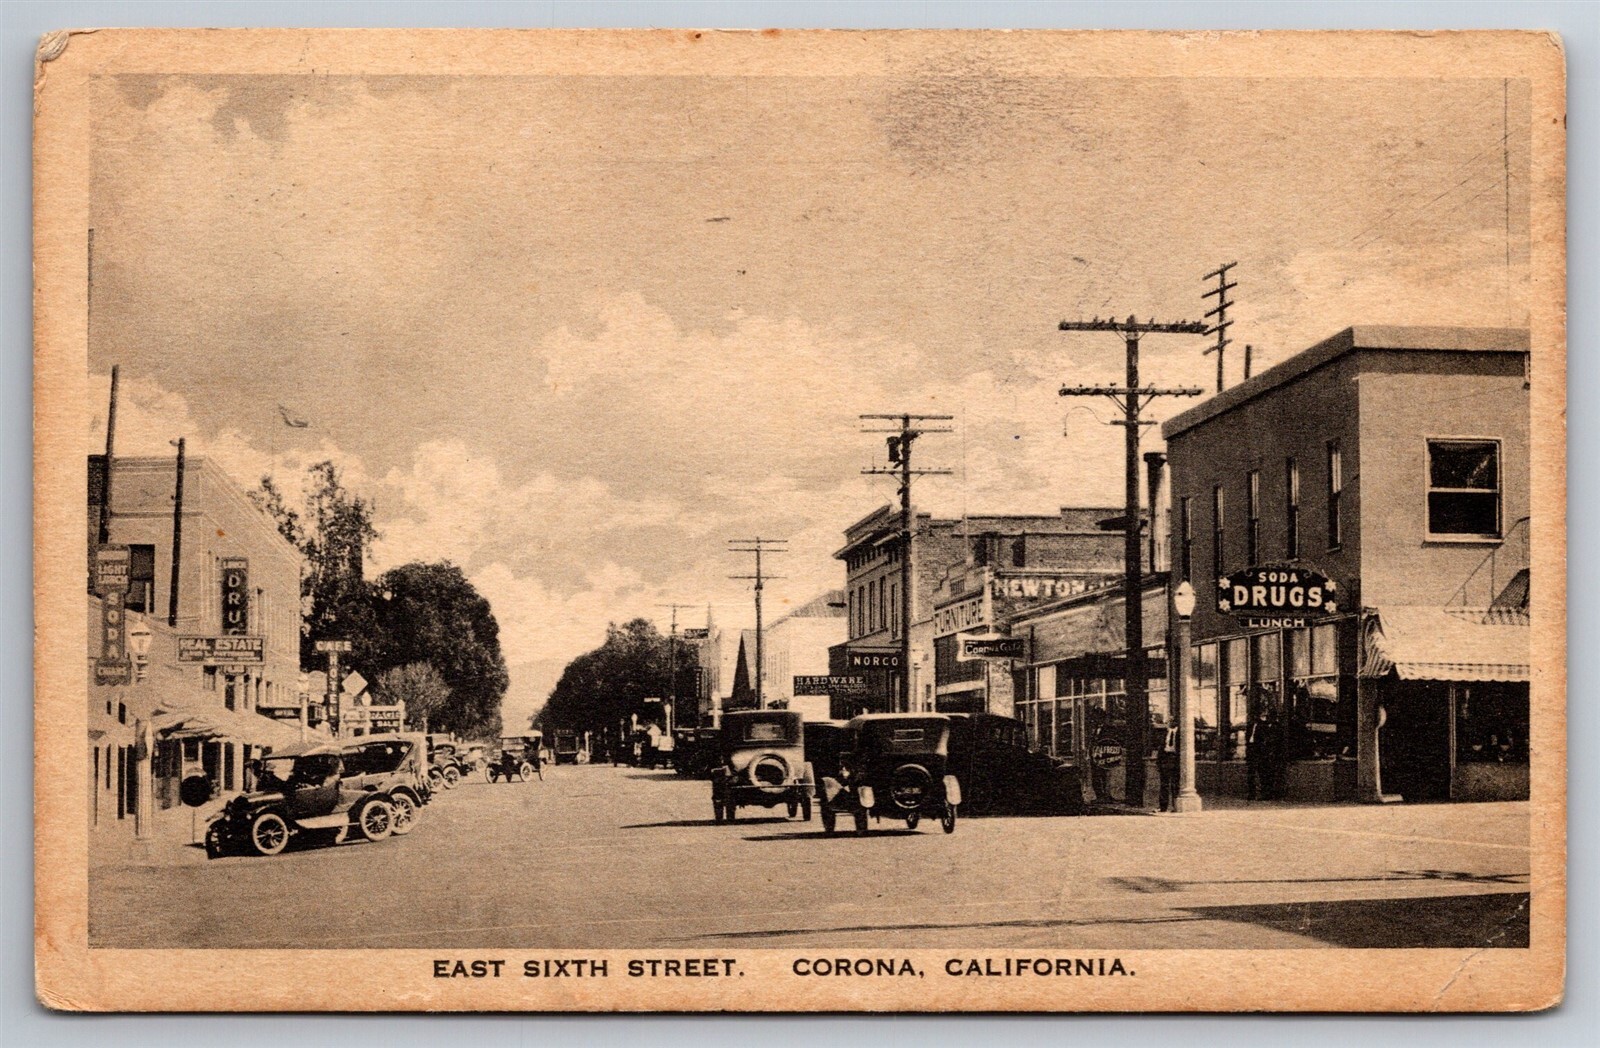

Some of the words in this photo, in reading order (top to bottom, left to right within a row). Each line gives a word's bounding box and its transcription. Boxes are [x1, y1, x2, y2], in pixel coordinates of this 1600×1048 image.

[98, 564, 128, 575] LIGHT
[1259, 572, 1298, 583] SODA
[994, 579, 1086, 599] NEWTON
[1233, 585, 1323, 608] DRUGS
[933, 598, 984, 635] FURNITURE
[107, 591, 119, 658] SODA
[1248, 618, 1305, 628] LUNCH
[180, 639, 211, 650] REAL
[215, 639, 262, 650] ESTATE
[316, 640, 351, 651] CAFE
[853, 656, 899, 667] NORCO
[329, 653, 338, 717] HOTEL
[796, 676, 864, 685] HARDWARE
